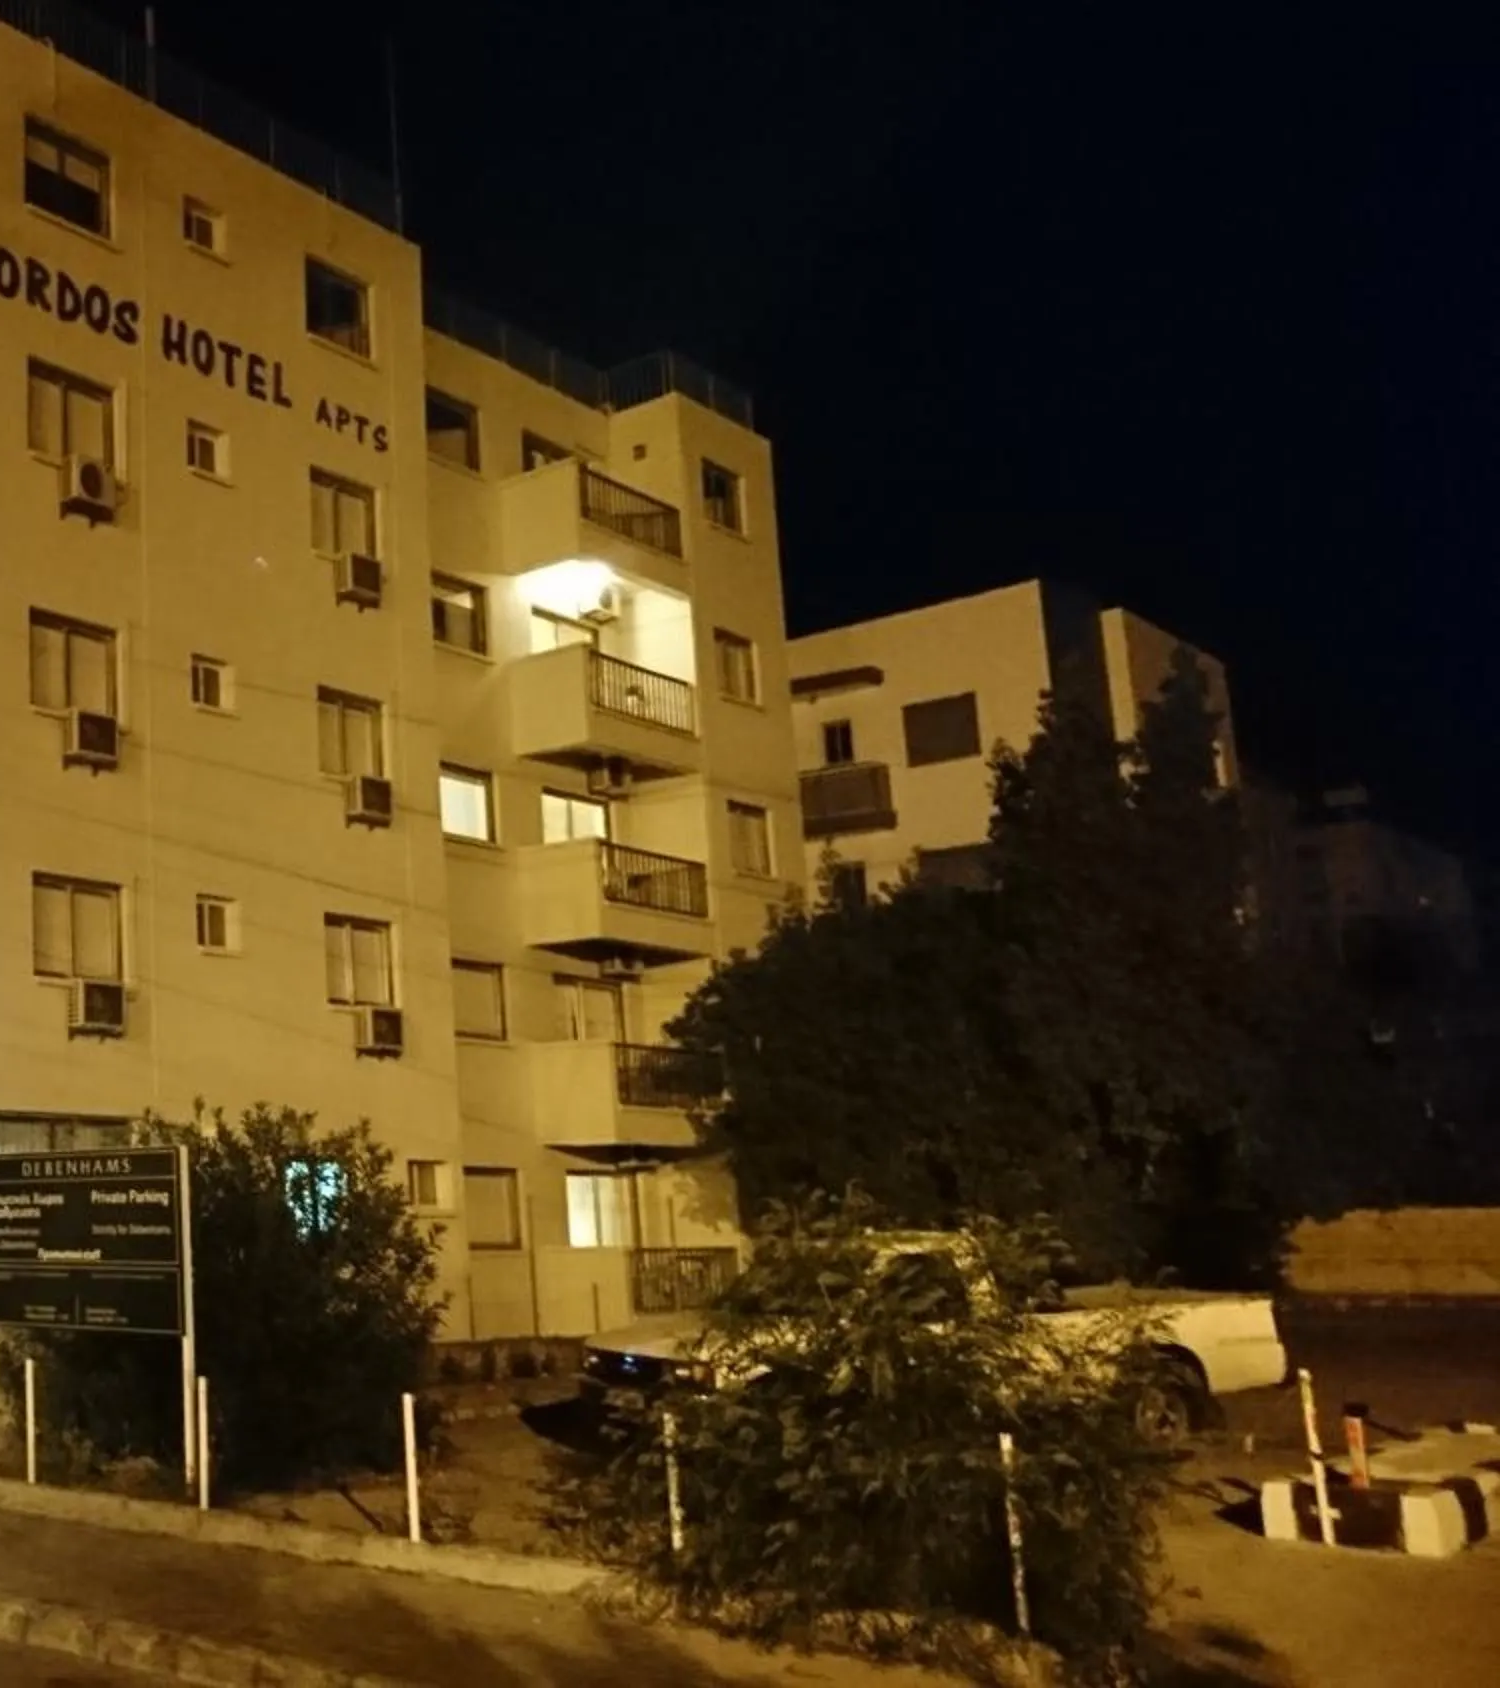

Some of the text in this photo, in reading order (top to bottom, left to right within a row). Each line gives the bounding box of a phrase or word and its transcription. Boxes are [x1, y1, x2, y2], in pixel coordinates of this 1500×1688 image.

[162, 313, 293, 408] HOTEL
[315, 397, 389, 453] APTS
[21, 1157, 132, 1177] DEBENHAMS
